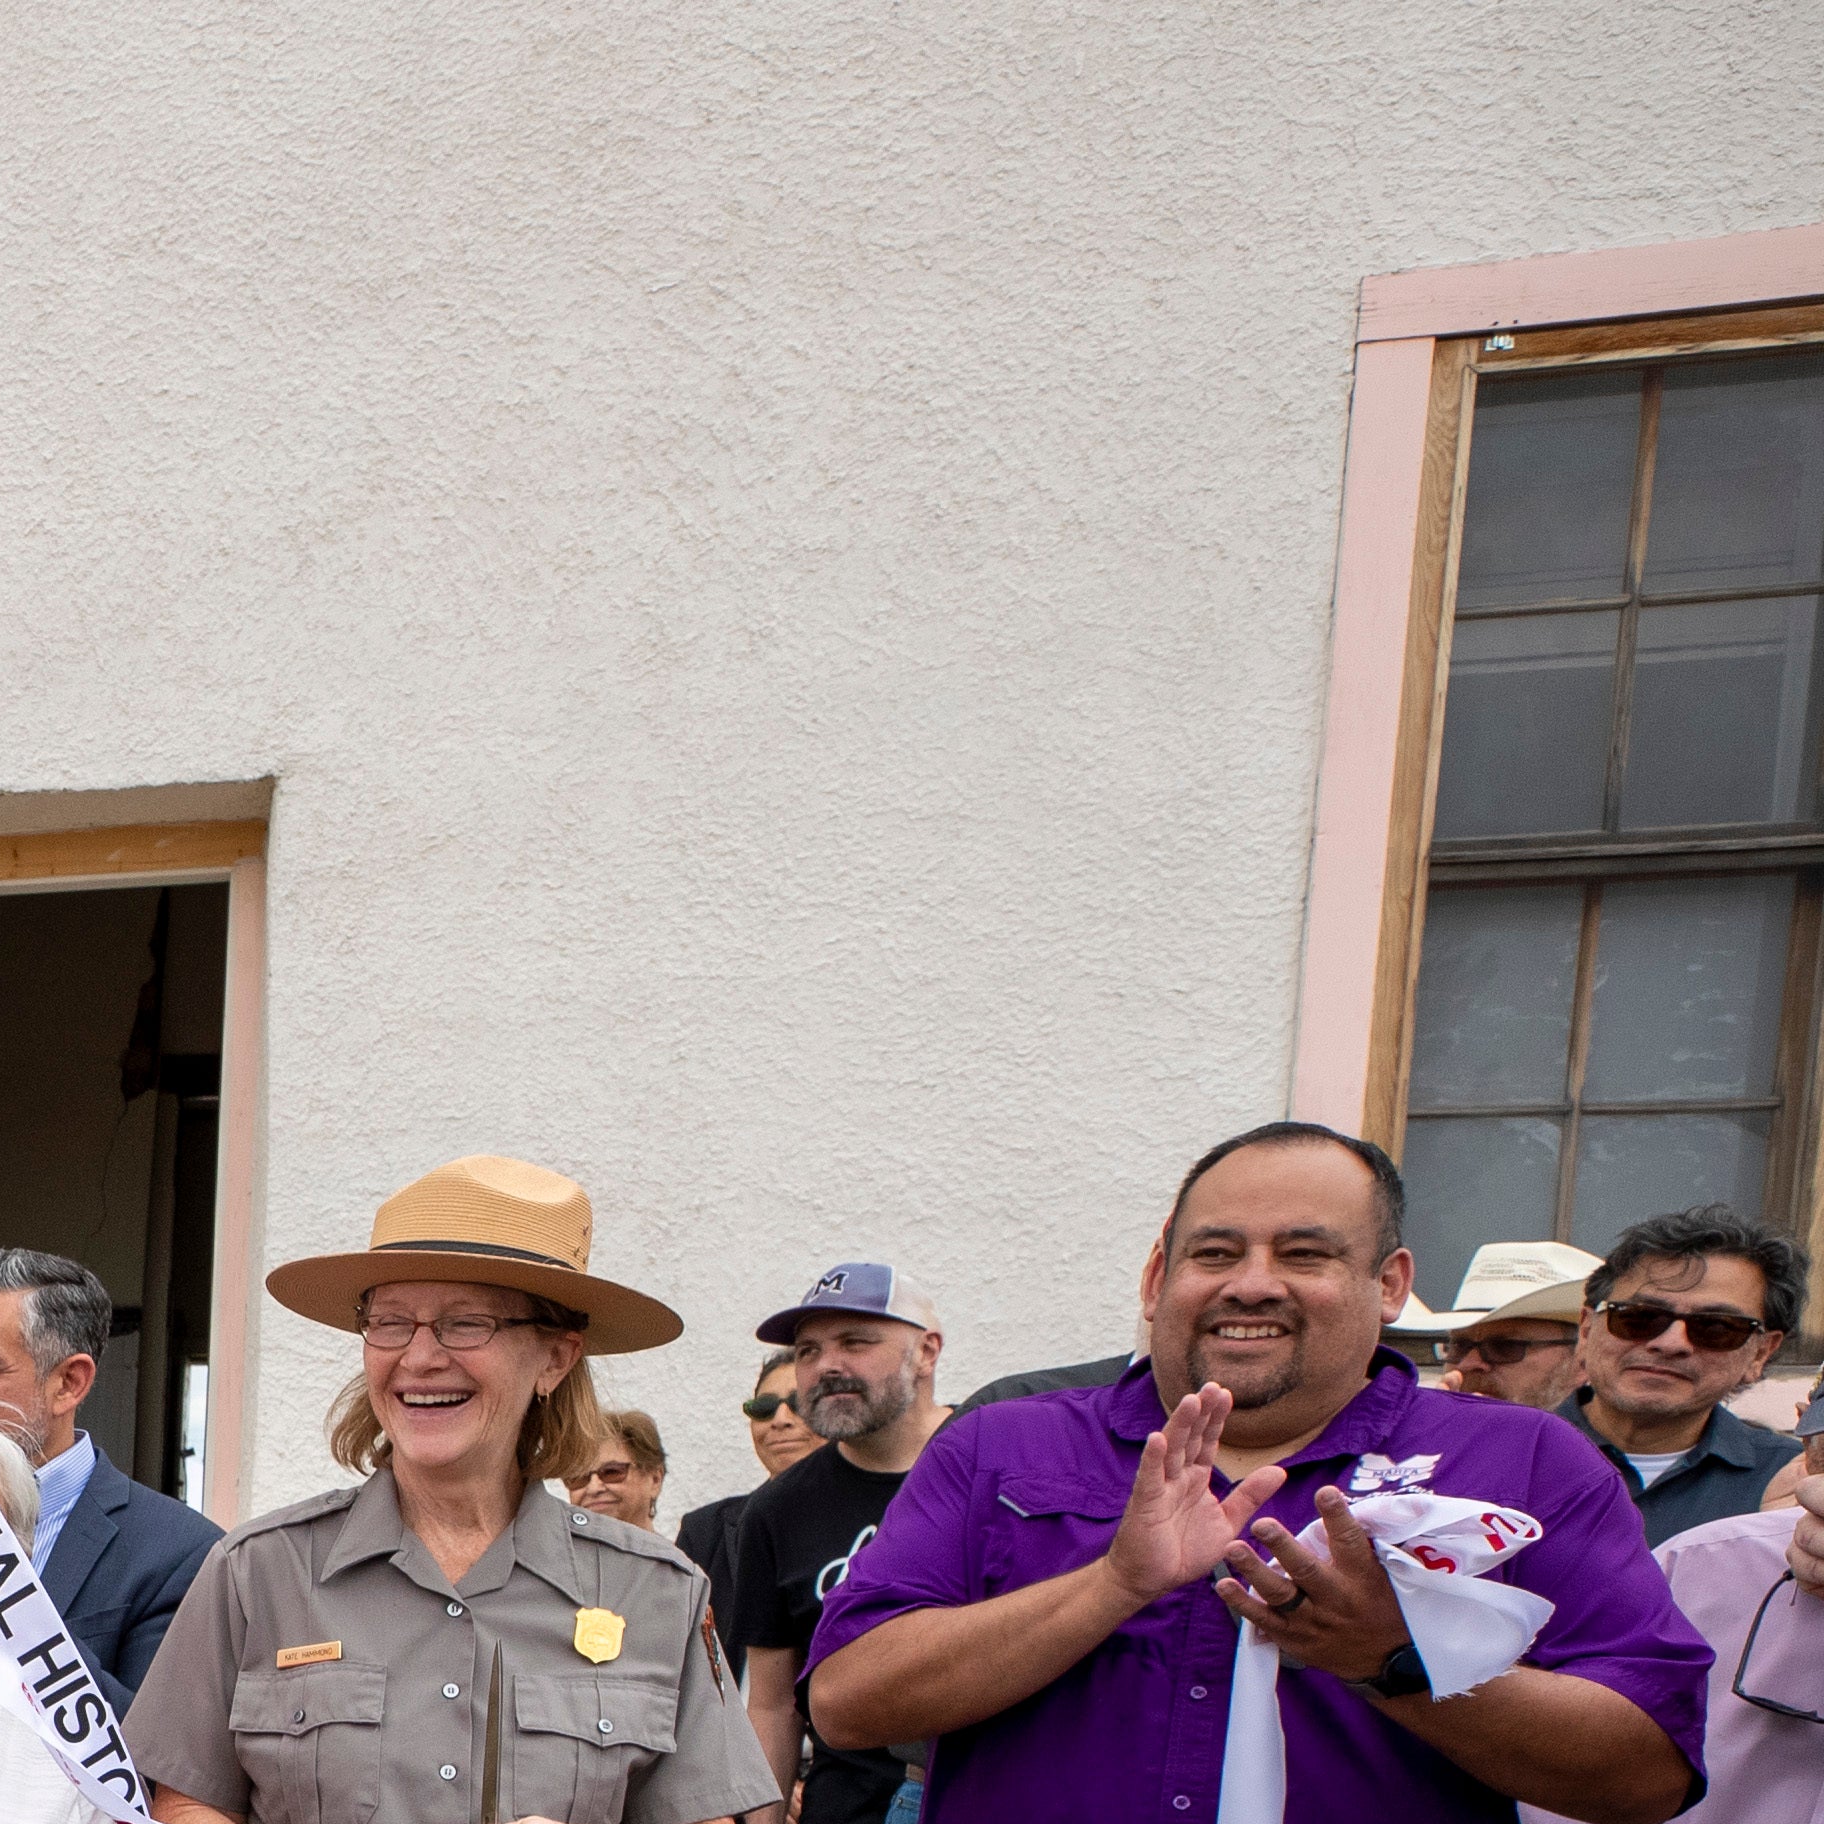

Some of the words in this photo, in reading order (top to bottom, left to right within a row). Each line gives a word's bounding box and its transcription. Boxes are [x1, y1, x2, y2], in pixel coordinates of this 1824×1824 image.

[284, 1652, 299, 1661] KATE
[301, 1647, 333, 1659] HAMMOND
[16, 1632, 146, 1816] HISTO
